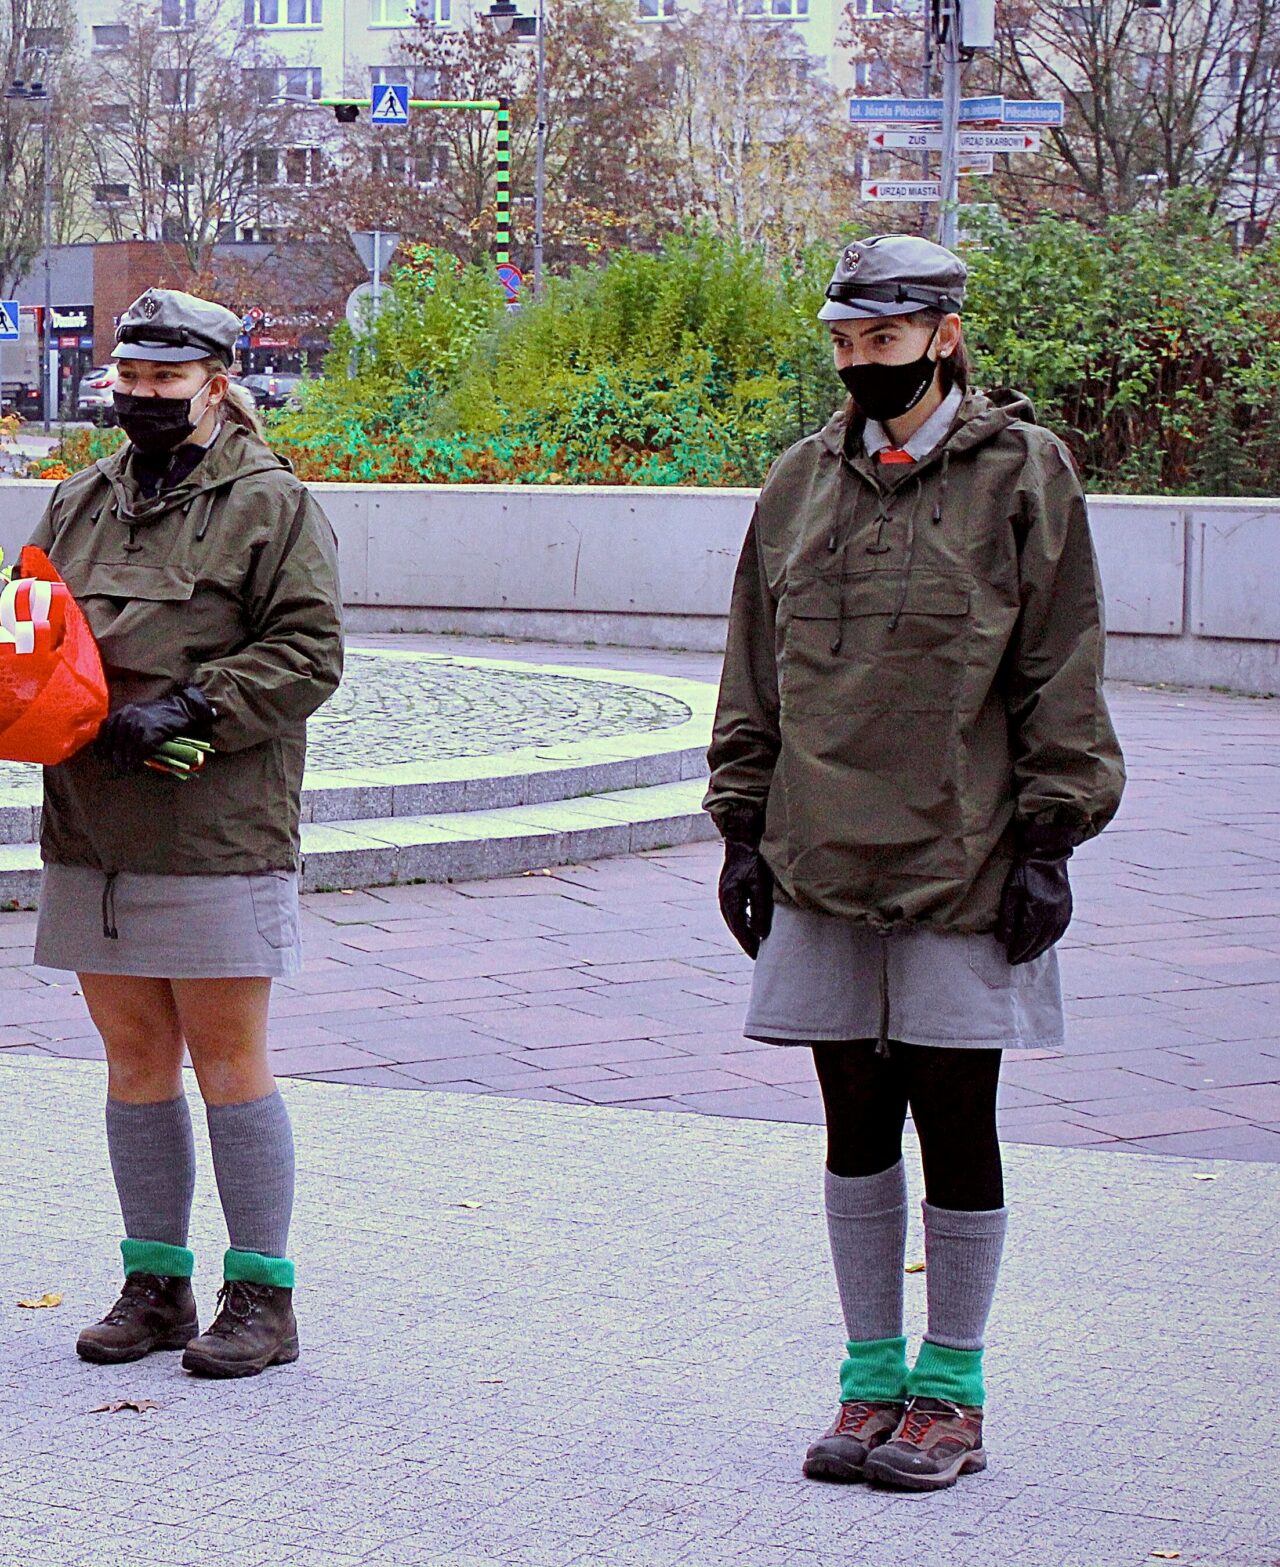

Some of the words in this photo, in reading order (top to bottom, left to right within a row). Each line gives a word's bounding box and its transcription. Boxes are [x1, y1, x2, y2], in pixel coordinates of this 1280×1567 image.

[894, 104, 944, 118] Piłsudskieg
[1005, 105, 1060, 121] Piłsudskiego
[908, 135, 927, 145] ZUS
[985, 136, 1023, 147] SKARBOWY
[880, 186, 907, 197] URZĄD
[908, 186, 937, 196] MIASTA
